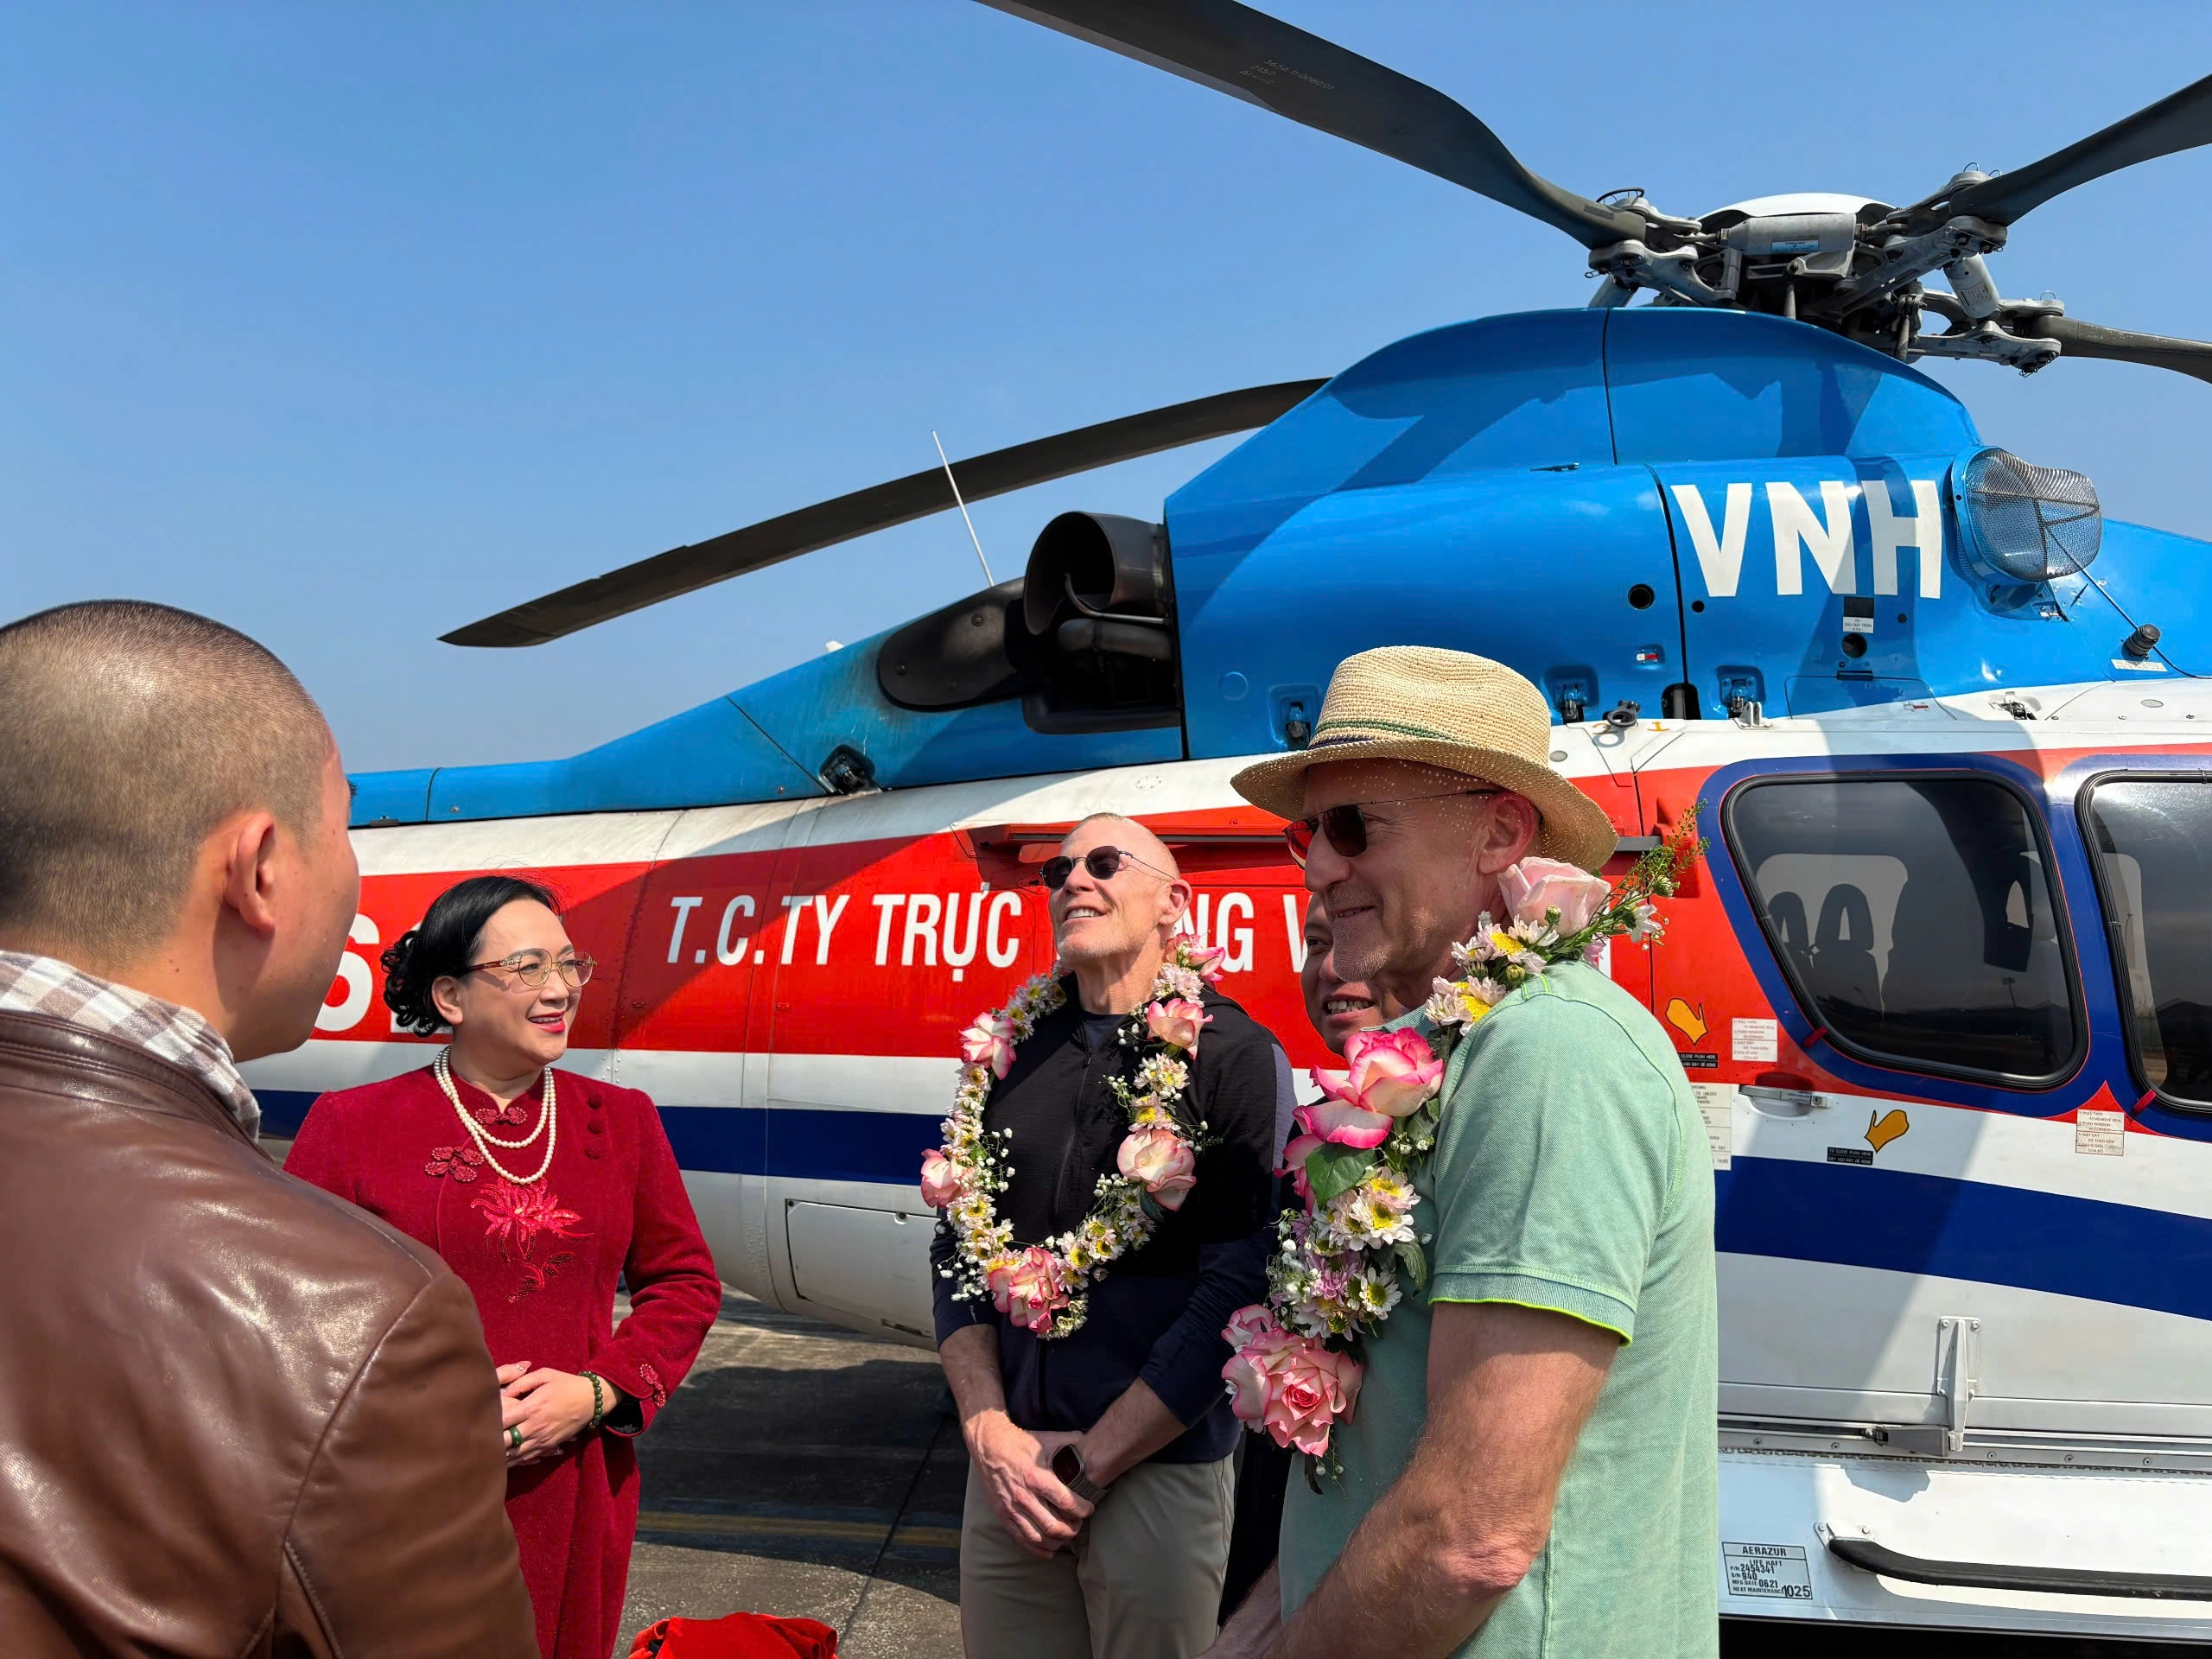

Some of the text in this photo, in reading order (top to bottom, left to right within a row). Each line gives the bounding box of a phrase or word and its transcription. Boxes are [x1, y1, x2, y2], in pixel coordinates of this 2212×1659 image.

[1670, 480, 1942, 599] VNH
[871, 882, 1022, 982] TRỰC
[1740, 1564, 1775, 1573] 2454341
[1742, 1546, 1787, 1556] AERAZUR
